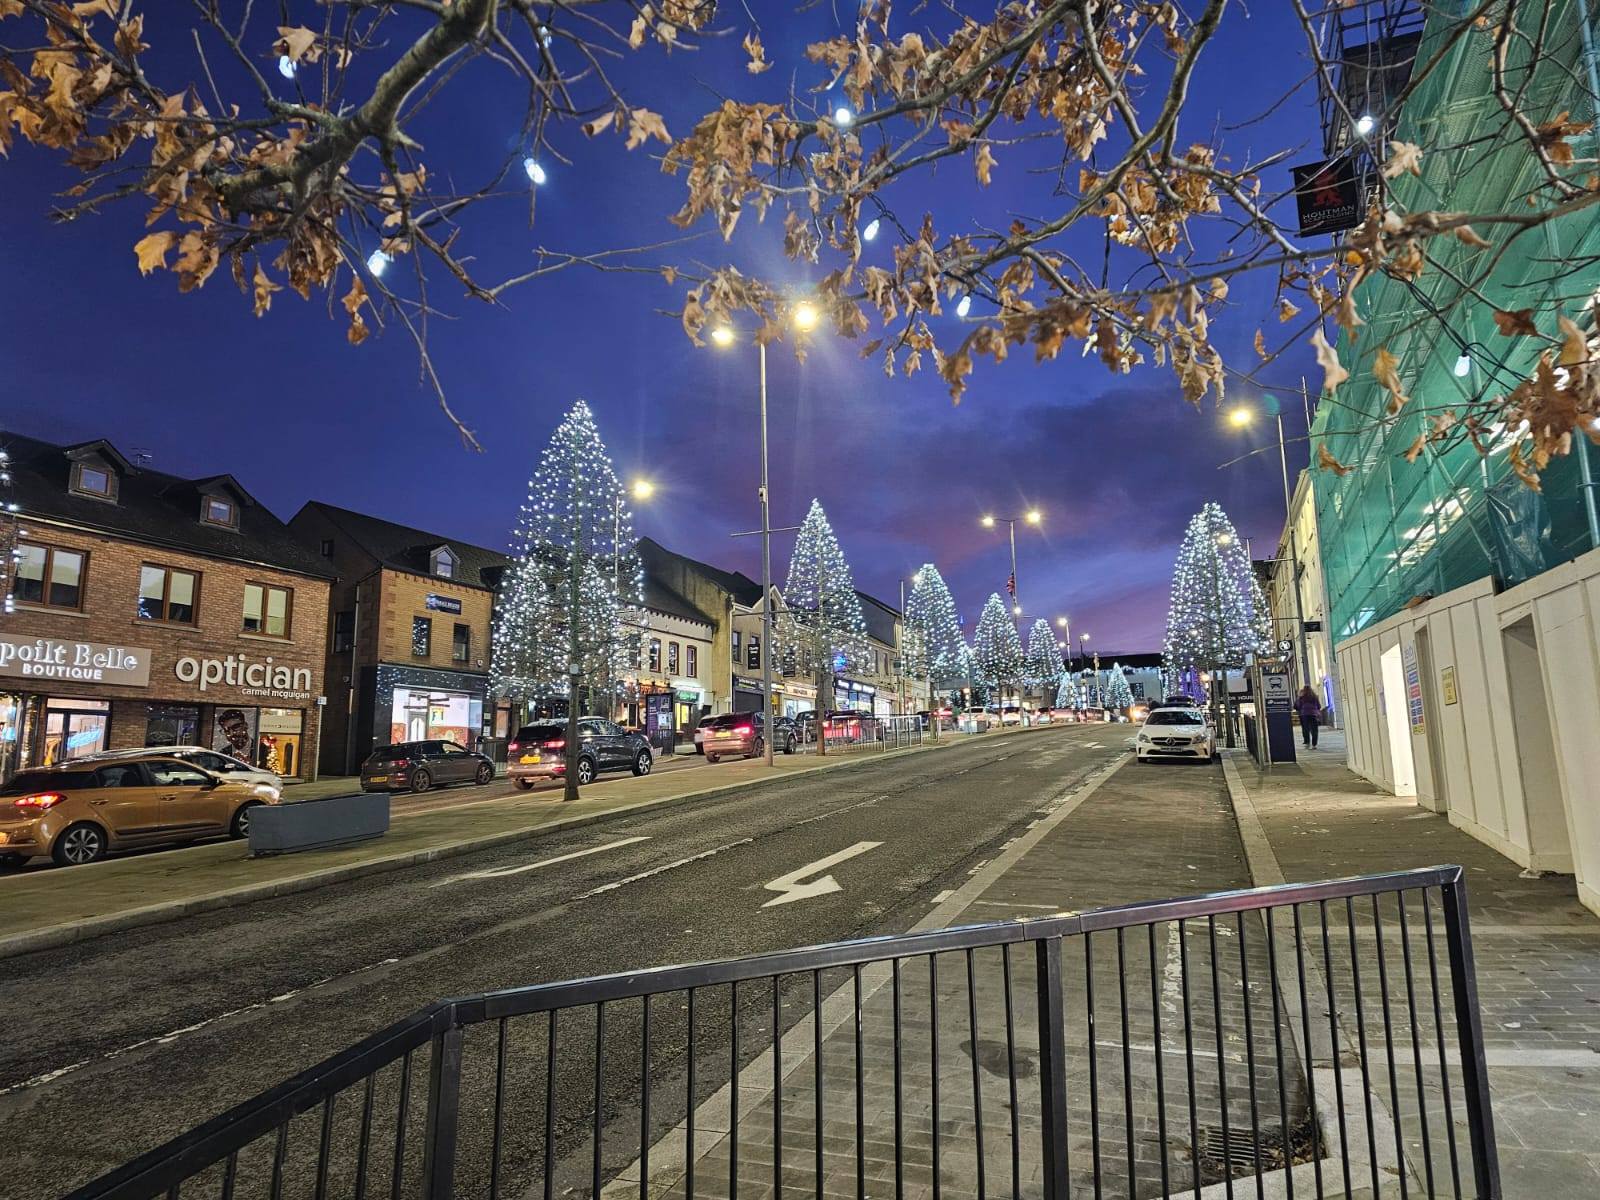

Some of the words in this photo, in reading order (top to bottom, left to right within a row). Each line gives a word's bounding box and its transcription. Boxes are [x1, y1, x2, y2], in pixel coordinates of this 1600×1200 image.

[1302, 204, 1355, 220] HOUTMAN
[73, 644, 138, 671] Belle
[22, 663, 103, 680] BOUTIQUE
[175, 654, 312, 691] optician
[241, 687, 271, 698] carmel
[271, 689, 310, 699] mcguigan
